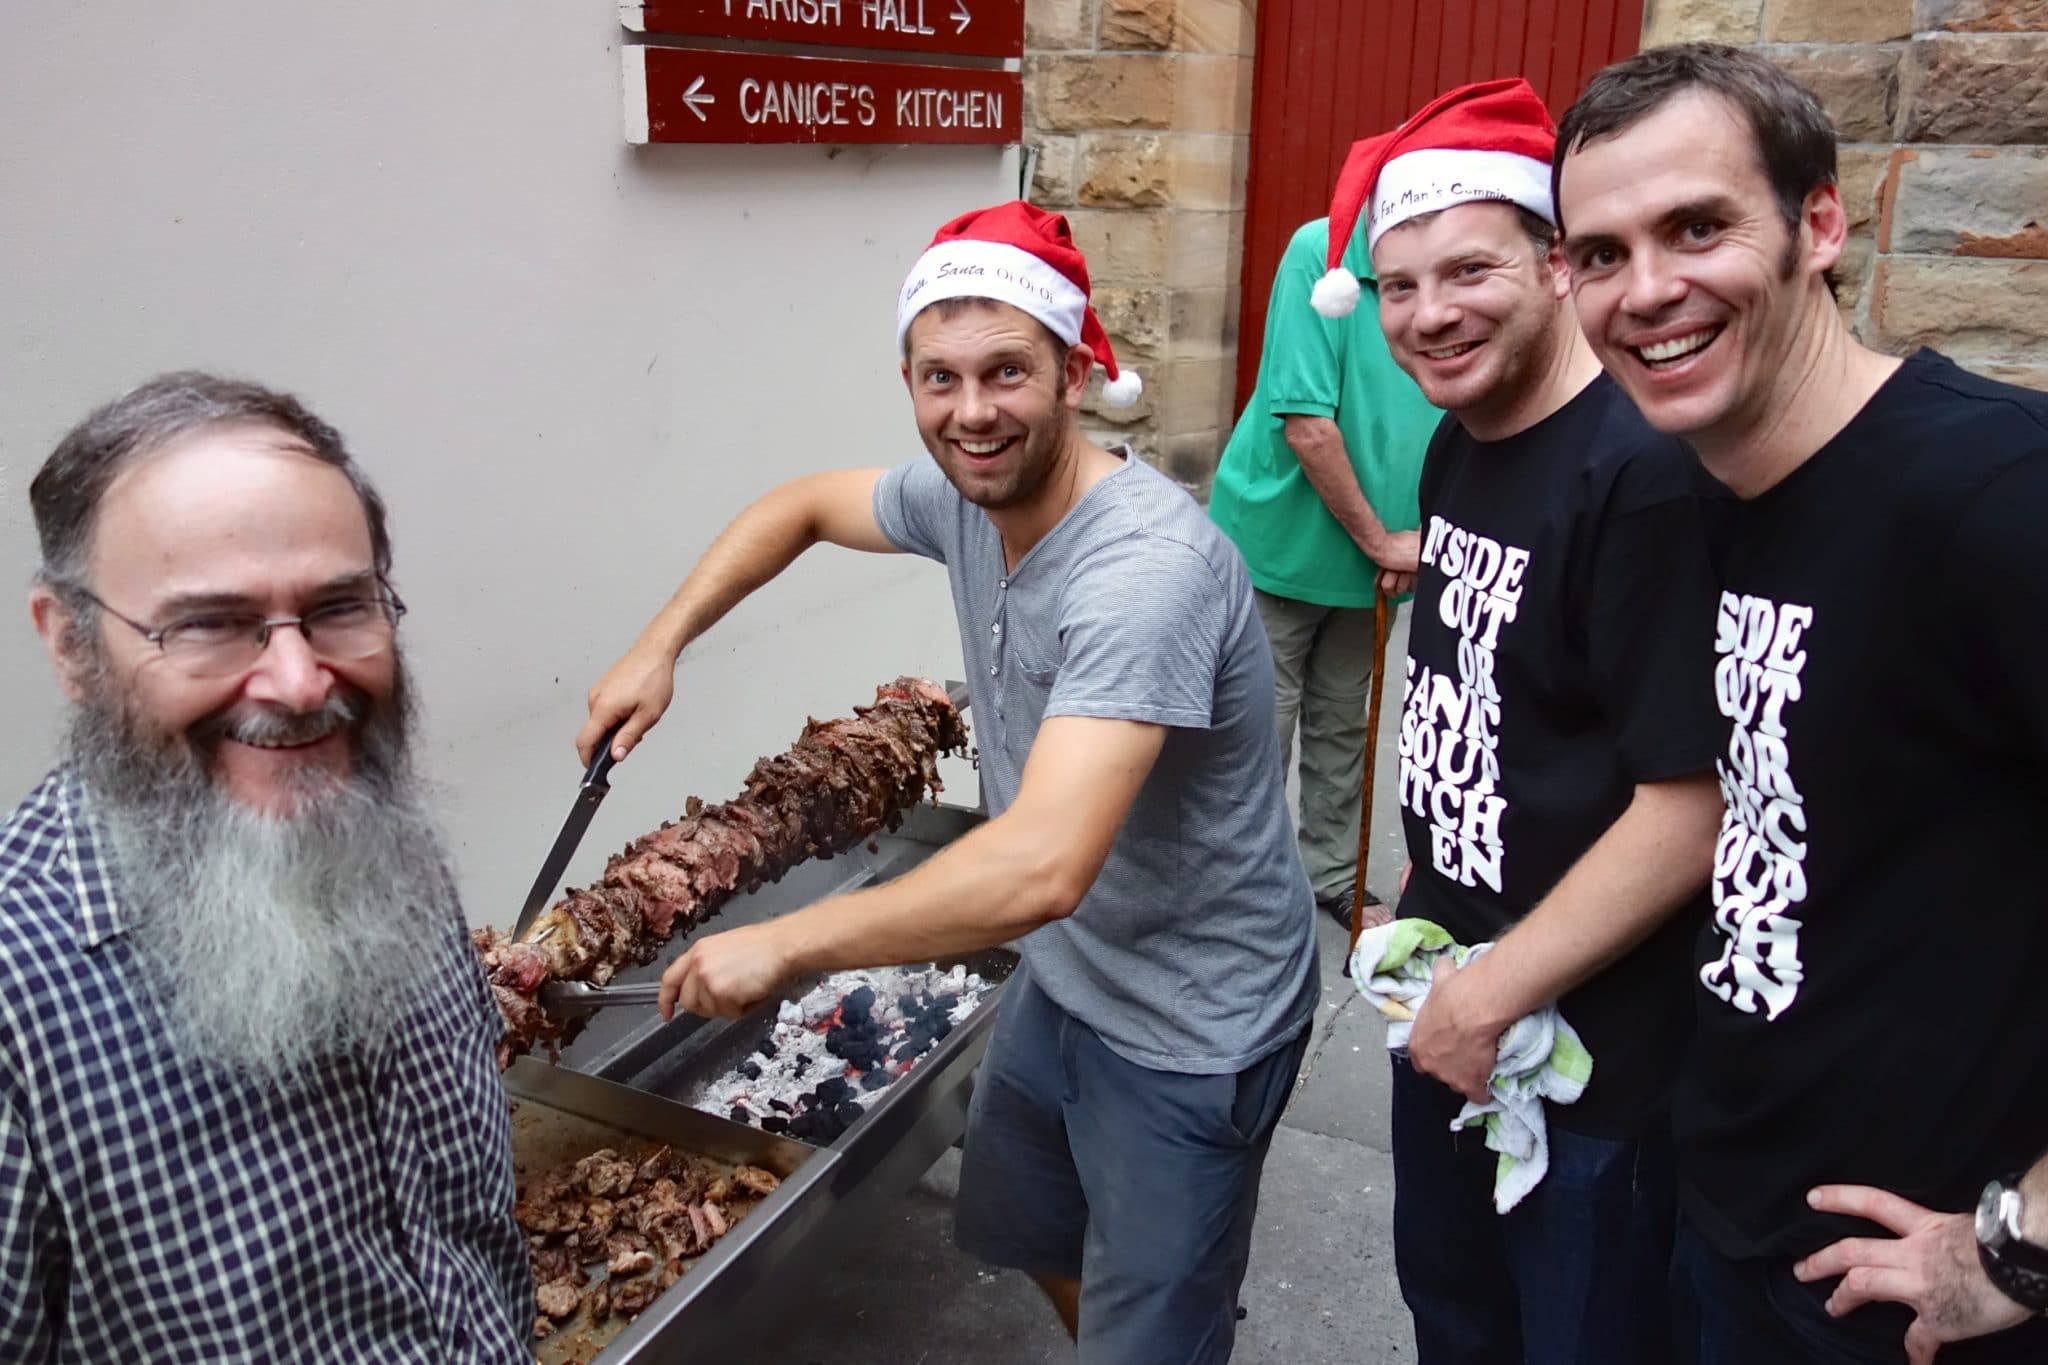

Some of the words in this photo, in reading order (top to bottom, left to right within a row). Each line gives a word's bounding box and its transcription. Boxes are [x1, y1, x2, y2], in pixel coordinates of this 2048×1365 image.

[862, 0, 935, 35] HALL
[738, 78, 877, 126] CANICE'S
[897, 89, 1003, 128] KITCHEN
[937, 262, 984, 279] Santa
[1439, 578, 1517, 650] OUT
[1457, 636, 1501, 703] OR
[1399, 757, 1508, 847] ITCH
[1430, 824, 1504, 894] EN
